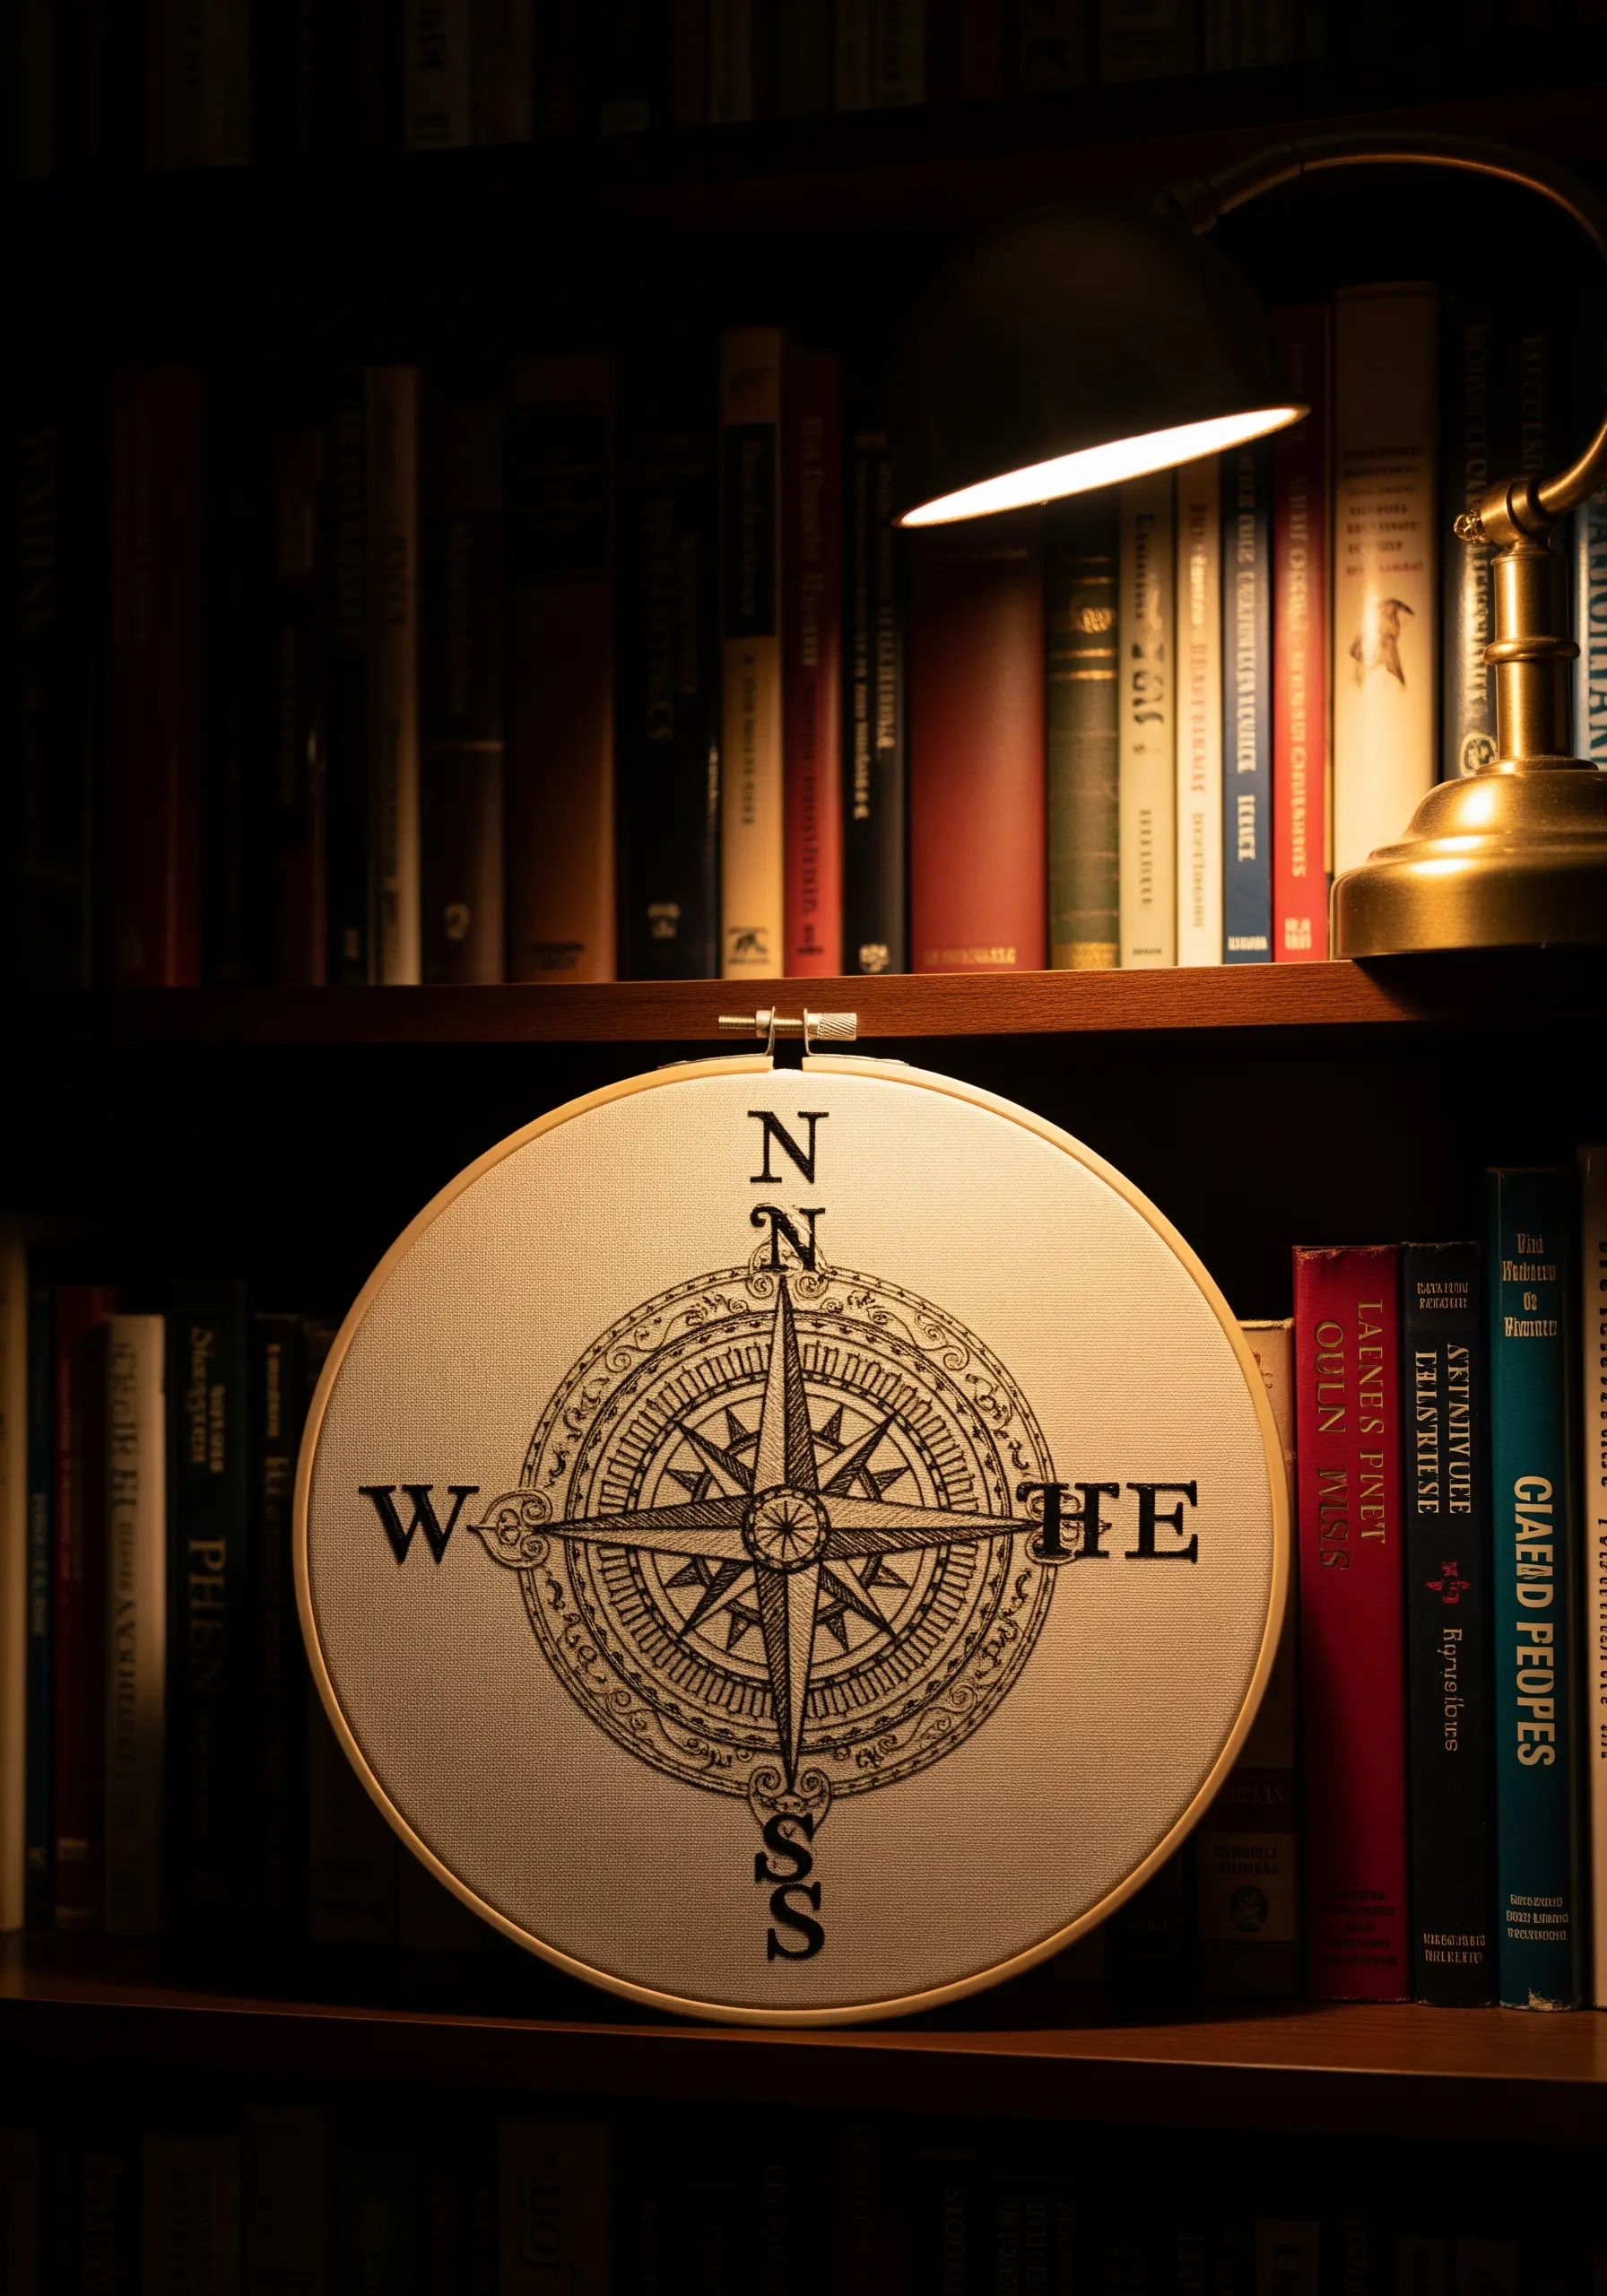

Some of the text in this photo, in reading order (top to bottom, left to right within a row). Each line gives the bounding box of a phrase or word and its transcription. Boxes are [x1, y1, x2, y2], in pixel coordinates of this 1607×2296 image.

[747, 1110, 829, 1183] N
[751, 1205, 825, 1271] N
[359, 1485, 480, 1564] W
[1516, 1622, 1556, 1766] PEOPES
[754, 1813, 815, 1884] S
[768, 1882, 825, 1961] S
